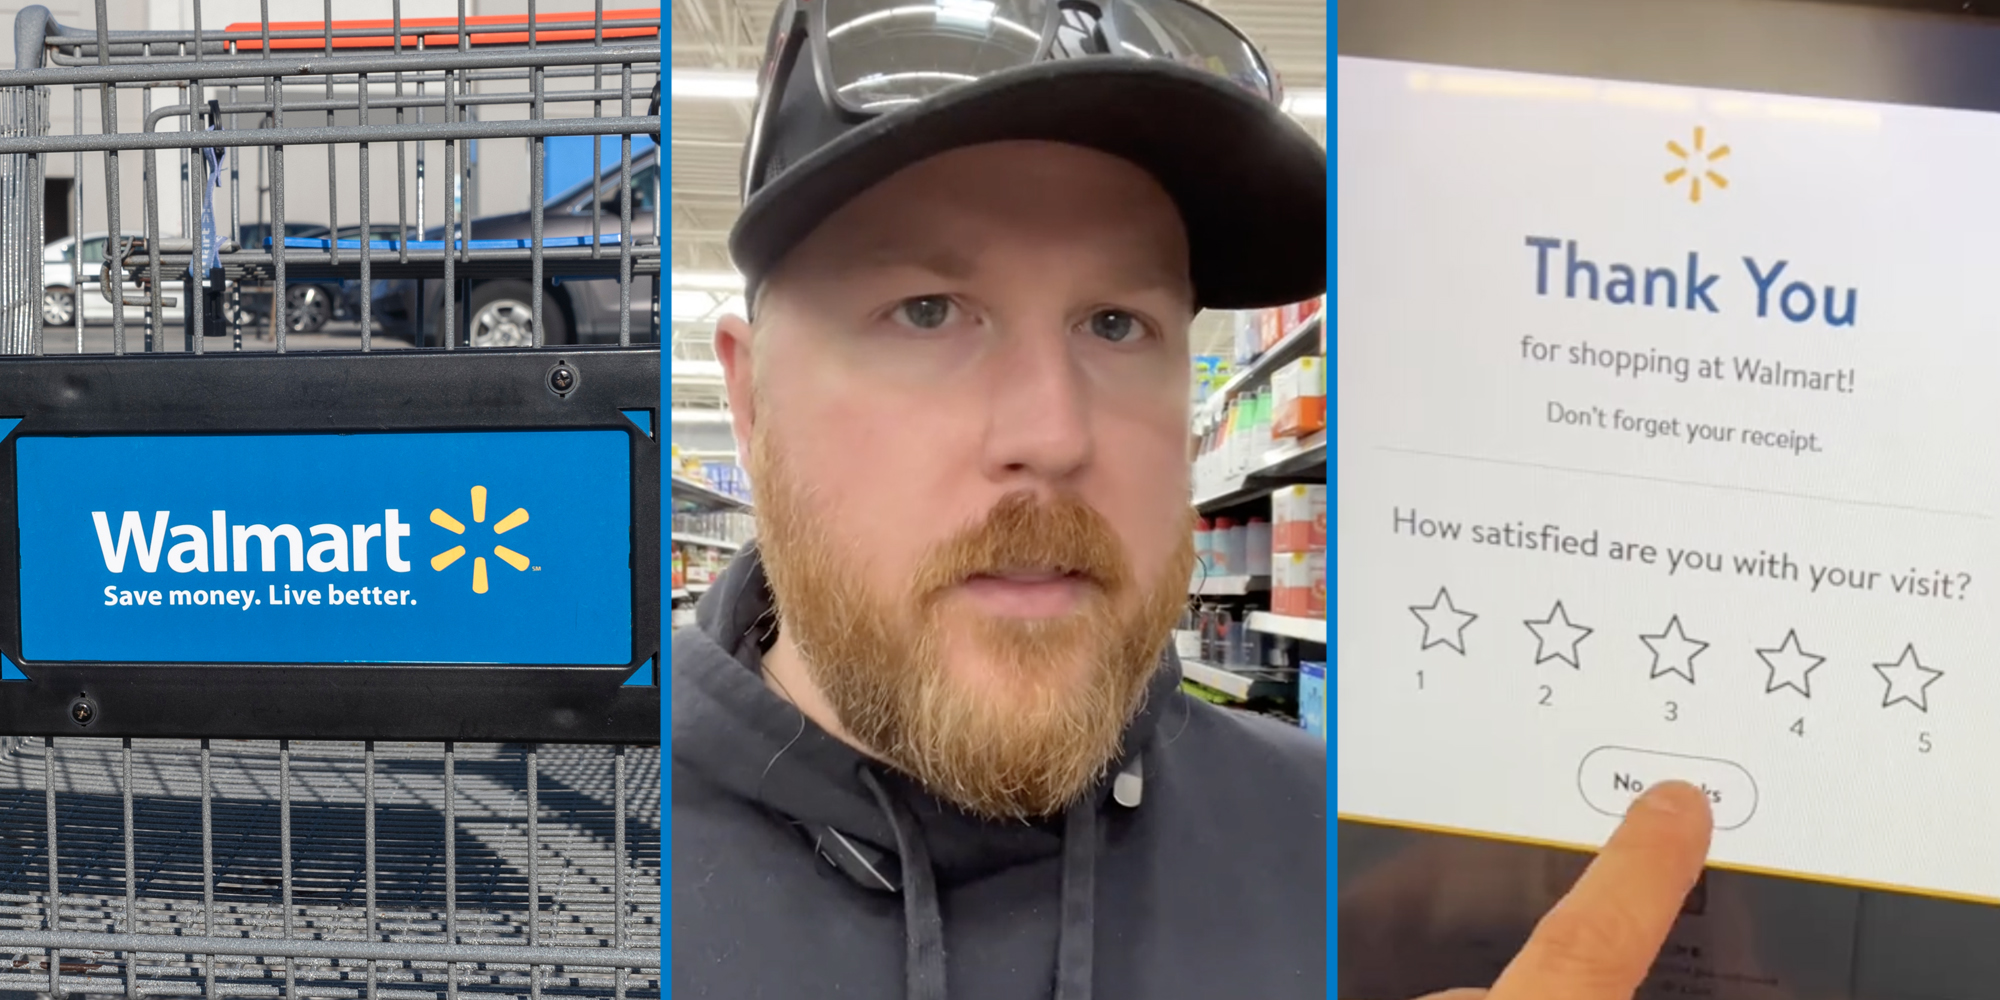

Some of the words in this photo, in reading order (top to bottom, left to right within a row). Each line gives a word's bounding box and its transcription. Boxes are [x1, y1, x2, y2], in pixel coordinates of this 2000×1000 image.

[1525, 235, 1720, 313] Thank
[1742, 256, 1857, 327] You
[1521, 335, 1561, 361] for
[1569, 341, 1689, 383] shopping
[1698, 357, 1724, 380] at
[1733, 357, 1855, 393] Walmart!
[1547, 401, 1606, 428] Don't
[1613, 409, 1680, 438] forget
[1686, 422, 1736, 444] your
[1742, 430, 1823, 456] receipt.
[92, 509, 410, 573] Walmart
[1393, 507, 1462, 540] How
[1472, 521, 1598, 557] satisfied
[1608, 541, 1657, 564] are
[1667, 548, 1722, 576] you
[1733, 550, 1798, 581] with
[1809, 565, 1881, 593] your
[1891, 567, 1972, 600] visit?
[104, 586, 162, 606] Save
[170, 590, 261, 610] money.
[270, 584, 321, 606] Live
[329, 584, 417, 606] better.
[1416, 670, 1424, 689] 1
[1538, 685, 1553, 706] 2
[1664, 701, 1678, 722] 3
[1789, 717, 1805, 738] 4
[1918, 732, 1932, 753] 5
[1614, 772, 1644, 792] No
